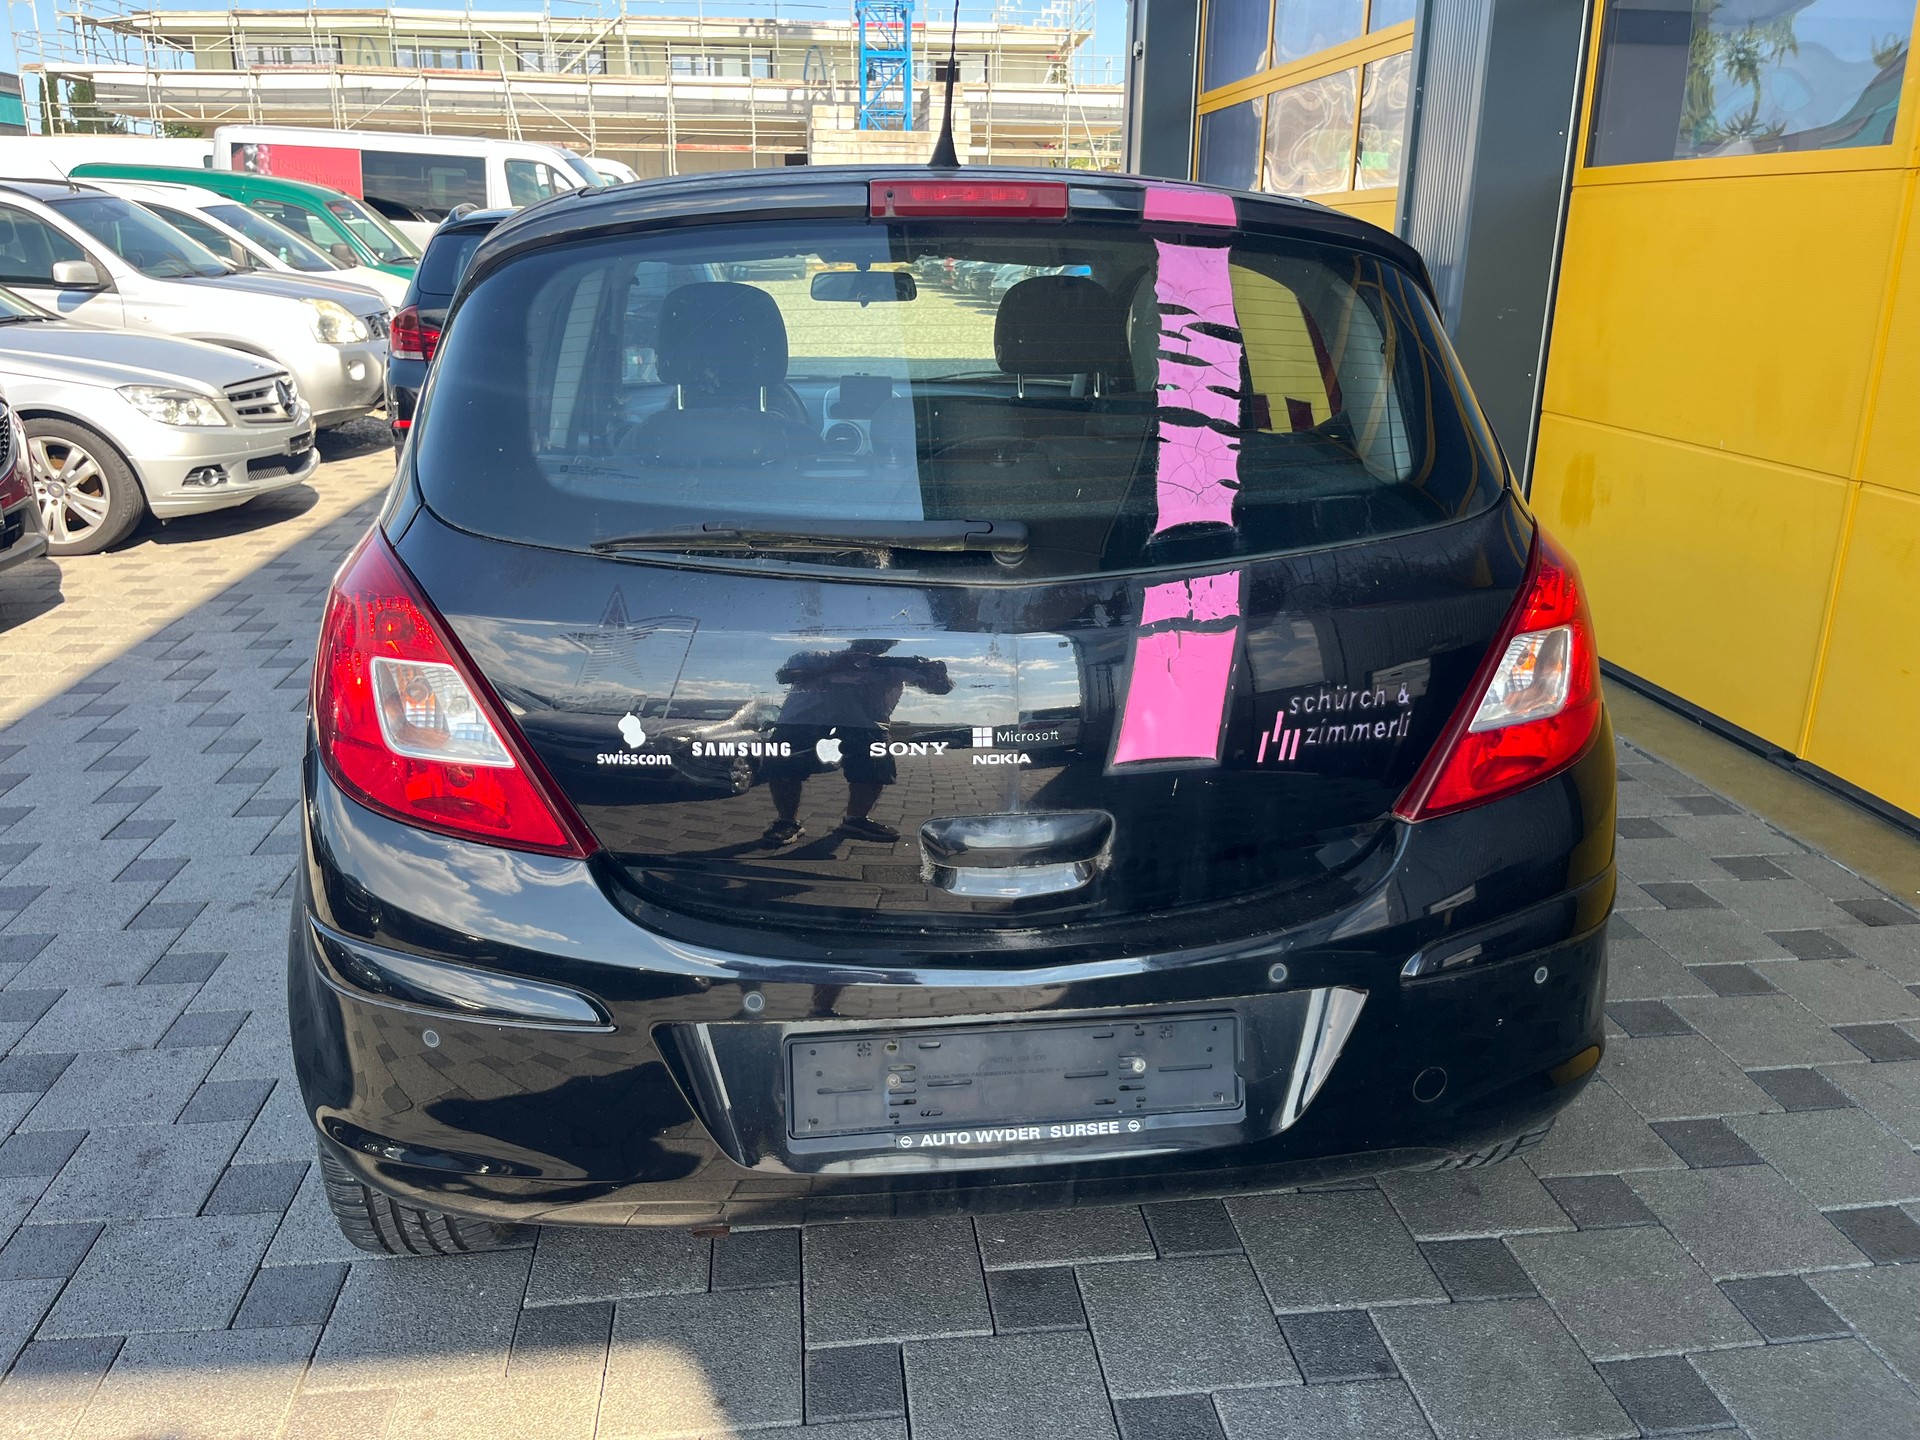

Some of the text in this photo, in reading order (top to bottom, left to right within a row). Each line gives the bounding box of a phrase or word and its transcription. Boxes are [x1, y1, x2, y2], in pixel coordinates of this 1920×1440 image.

[1290, 682, 1410, 714] schürch &
[997, 727, 1059, 743] Microsoft
[1304, 711, 1411, 744] zimmerli
[692, 741, 791, 757] SAMSUNG
[869, 741, 949, 757] SONY
[596, 750, 672, 765] swisscom
[972, 753, 1032, 766] NOKIA
[920, 1120, 1121, 1148] AUTO WYDER SURSEE
